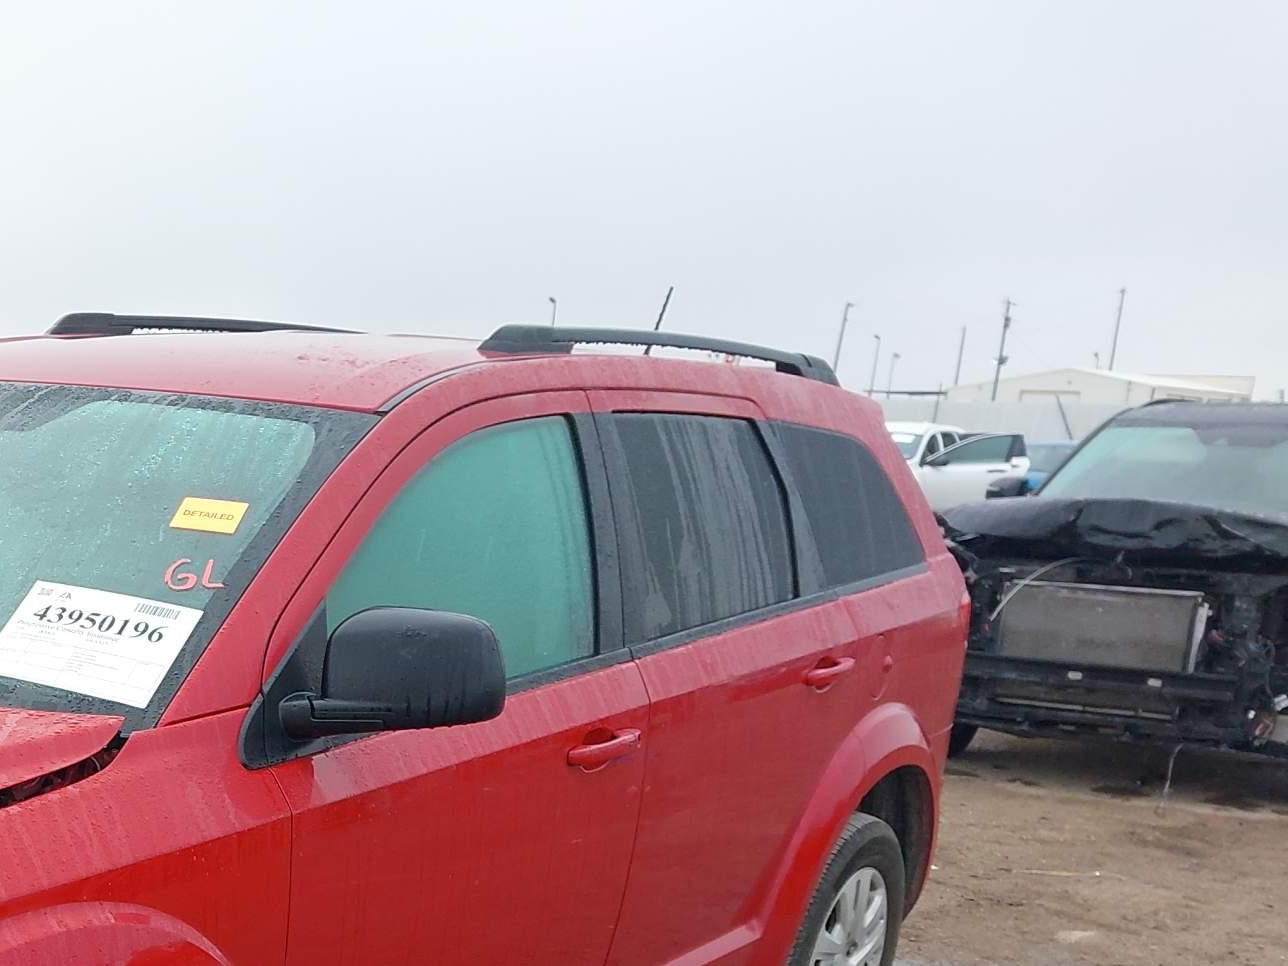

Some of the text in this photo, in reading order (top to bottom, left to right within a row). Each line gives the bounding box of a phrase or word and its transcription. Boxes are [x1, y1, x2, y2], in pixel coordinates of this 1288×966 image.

[183, 509, 234, 521] DETAILED
[164, 558, 225, 591] GL
[33, 605, 169, 643] 43950196
